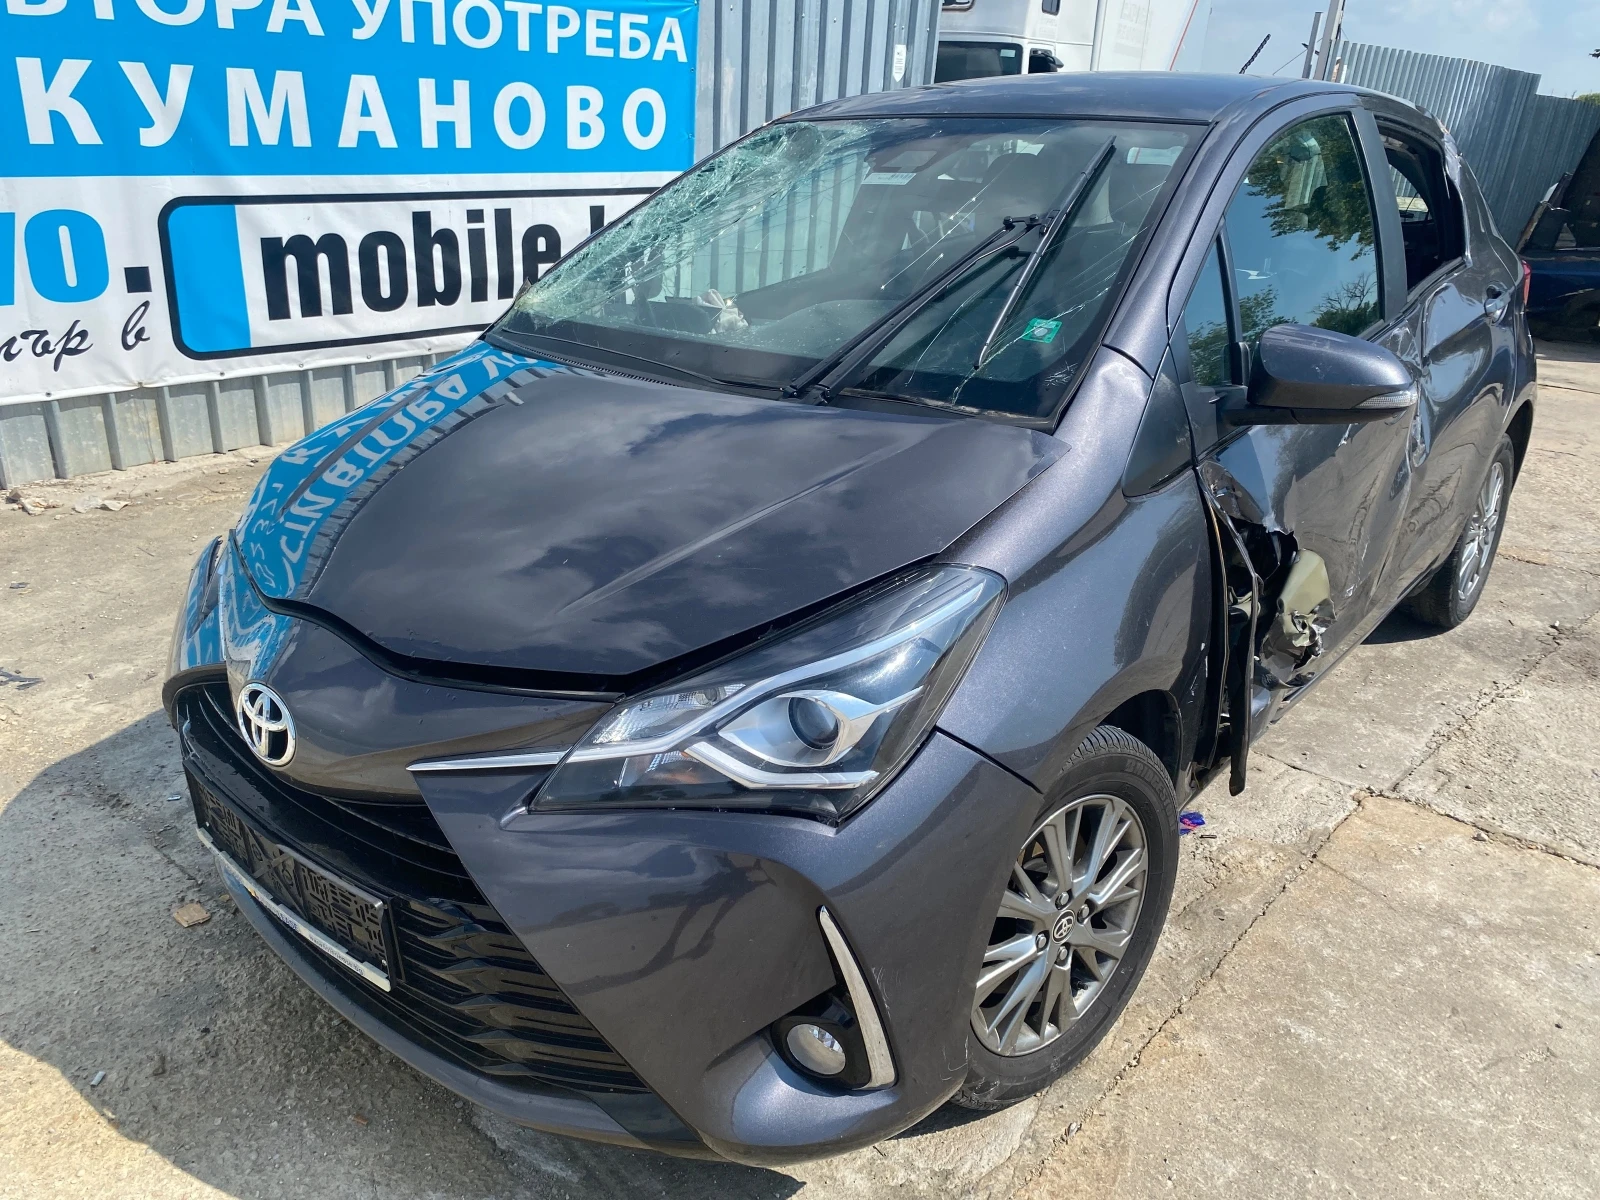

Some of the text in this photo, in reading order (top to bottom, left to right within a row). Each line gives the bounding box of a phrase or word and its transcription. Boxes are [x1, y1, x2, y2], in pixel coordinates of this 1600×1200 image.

[352, 0, 688, 63] УПОТРЕБА
[15, 56, 667, 151] КУМАНОВО
[260, 205, 605, 322] mobile
